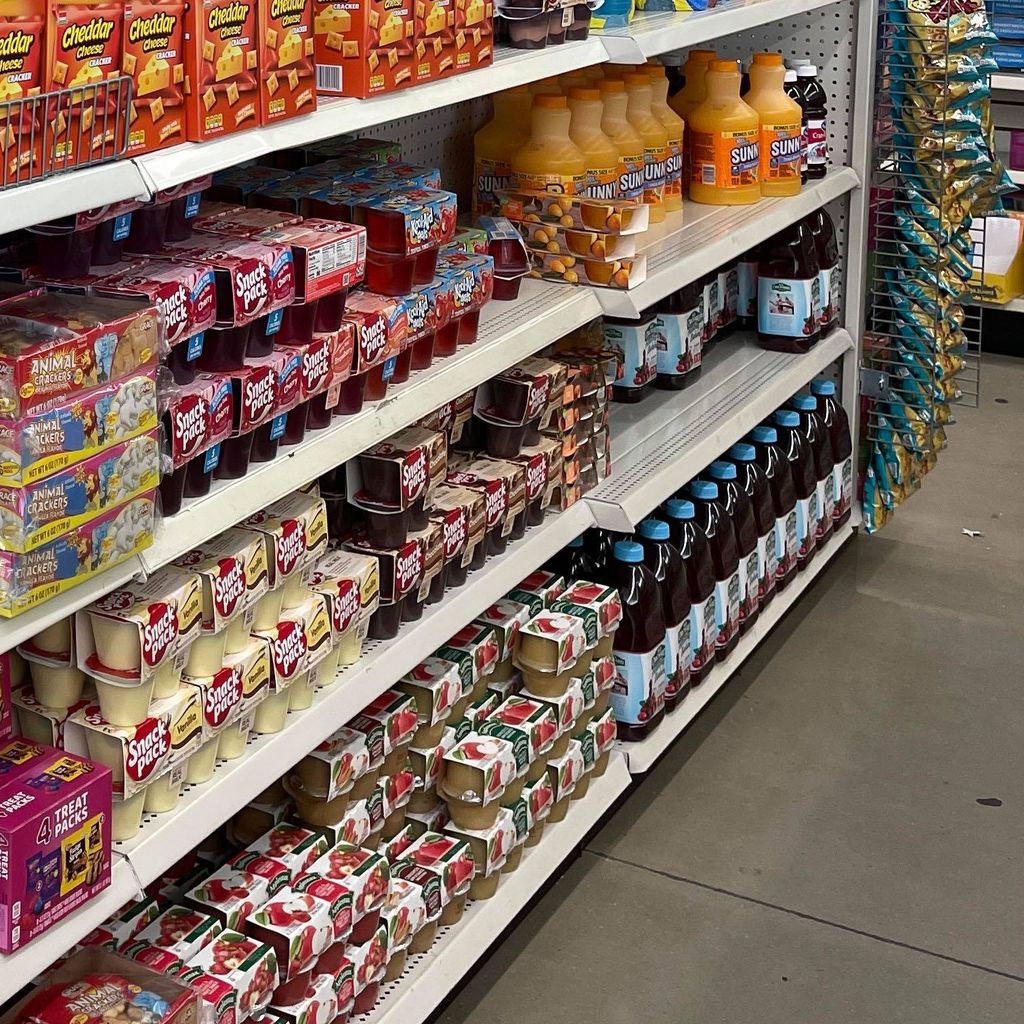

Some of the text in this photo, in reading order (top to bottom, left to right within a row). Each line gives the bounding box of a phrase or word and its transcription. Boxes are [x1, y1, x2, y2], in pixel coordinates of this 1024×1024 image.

[62, 18, 113, 48] Cheddar
[731, 142, 759, 164] SUNN
[237, 262, 266, 297] Snack
[244, 279, 267, 310] pack
[278, 274, 291, 288] Cherry
[35, 370, 71, 384] CRACKERS
[278, 521, 303, 558] Snack
[250, 557, 263, 576] Vanilla
[283, 541, 305, 572] pack
[216, 561, 242, 601] Snack
[183, 599, 199, 618] Vanilla
[223, 582, 245, 615] pack
[145, 605, 176, 651] Snack
[151, 628, 176, 664] pack
[207, 669, 240, 709] Snack
[214, 691, 240, 726] pack
[37, 792, 88, 845] 4 TREAT
[55, 807, 88, 837] PACKS
